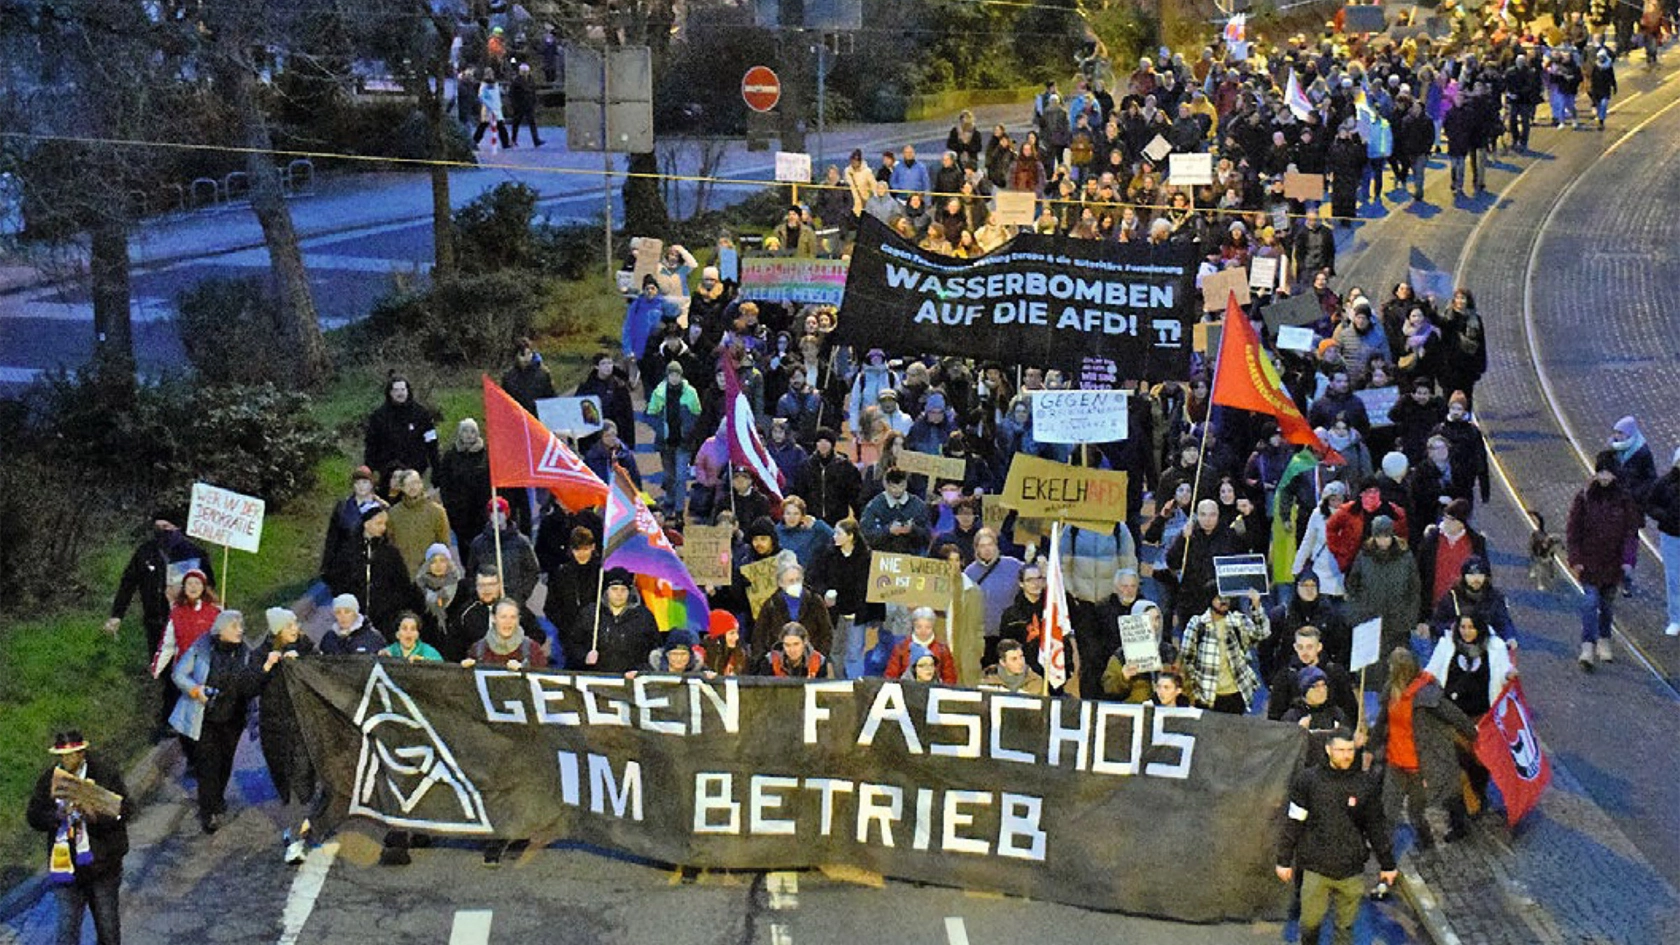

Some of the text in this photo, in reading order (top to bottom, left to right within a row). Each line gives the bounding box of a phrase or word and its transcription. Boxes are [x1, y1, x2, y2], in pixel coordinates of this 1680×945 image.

[885, 263, 1174, 308] WASSERBOMBEN
[914, 300, 1138, 337] AUF DIE AFD!
[1040, 392, 1109, 410] GEGEN
[1022, 476, 1121, 507] EKELHAFD
[880, 556, 903, 573] NIE
[474, 671, 1204, 779] GEGEN FASCHOS
[558, 751, 1047, 861] IM BETRIEB
